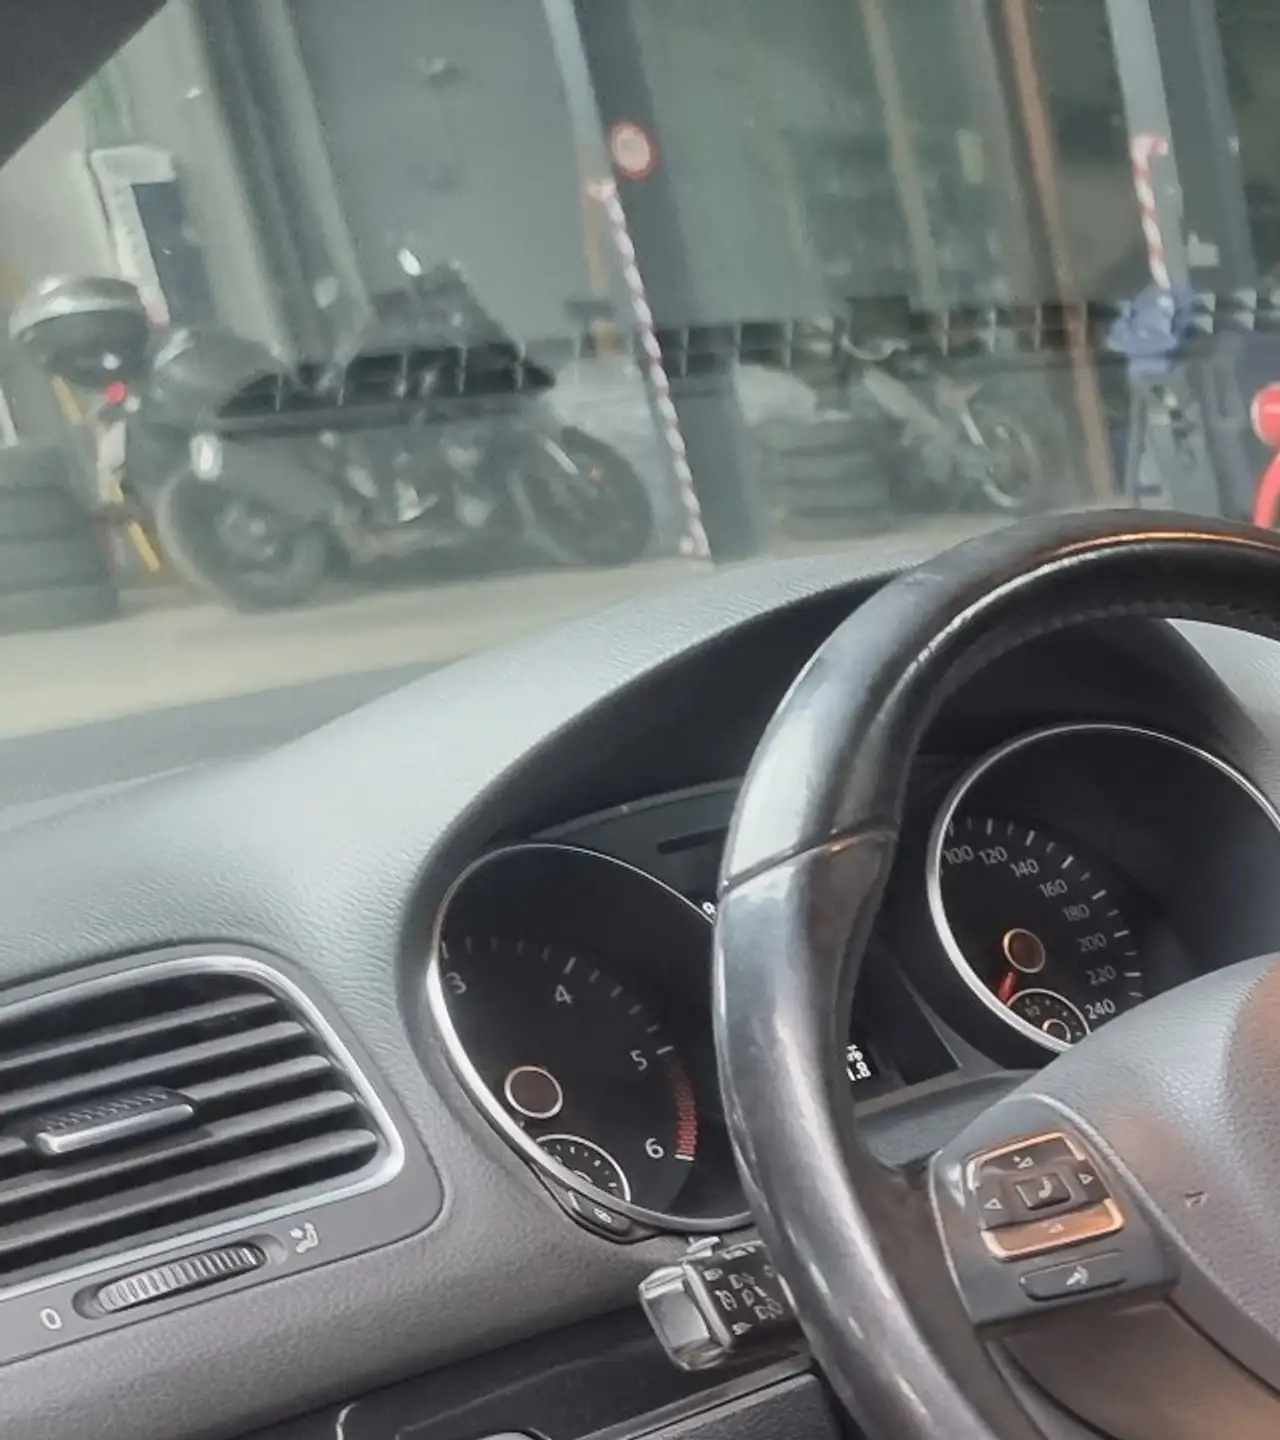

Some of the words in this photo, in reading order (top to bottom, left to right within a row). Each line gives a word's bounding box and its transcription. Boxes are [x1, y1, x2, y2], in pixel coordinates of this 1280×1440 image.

[944, 845, 974, 865] 100
[979, 846, 1008, 865] 120
[1010, 858, 1039, 877] 140
[1039, 879, 1068, 898] 160
[1063, 903, 1091, 921] 180
[1077, 932, 1107, 952] 200
[445, 972, 467, 994] 3
[1086, 965, 1116, 985] 220
[553, 984, 575, 1005] 4
[1085, 998, 1116, 1020] 240
[629, 1050, 648, 1071] 5
[645, 1137, 665, 1159] 6
